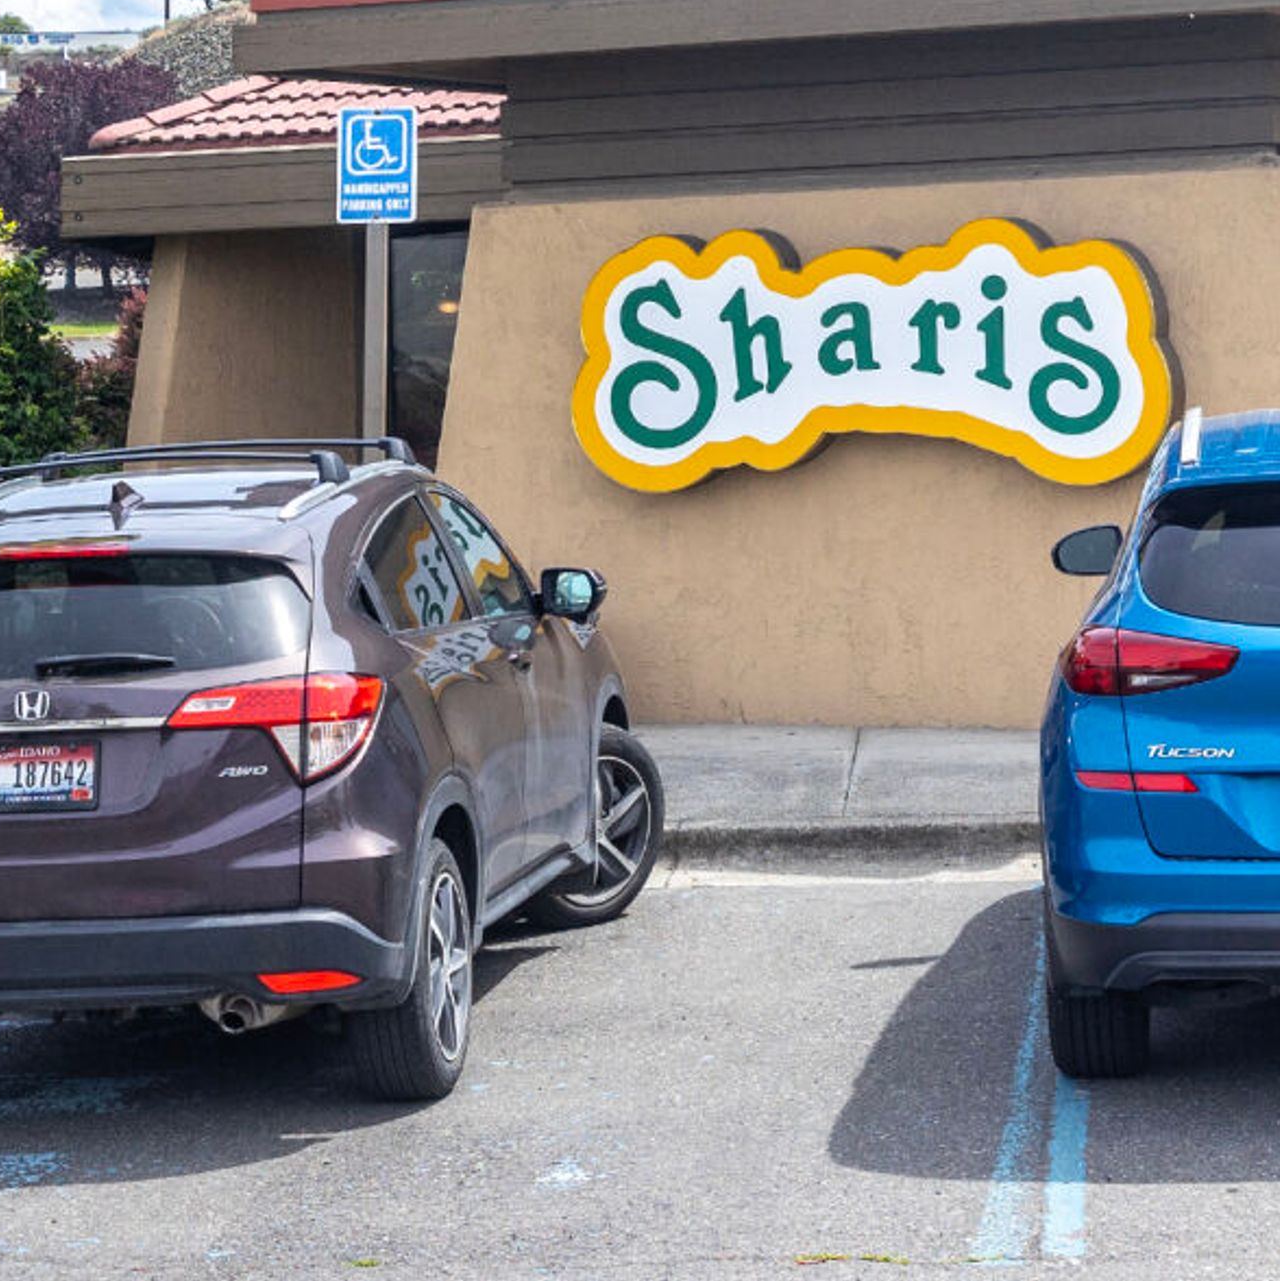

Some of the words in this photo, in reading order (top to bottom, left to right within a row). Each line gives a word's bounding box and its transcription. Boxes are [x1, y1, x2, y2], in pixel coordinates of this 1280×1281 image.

[343, 182, 410, 194] HANDICAPPED
[343, 199, 382, 211] PARKING
[385, 198, 410, 211] ONLY
[609, 274, 1121, 449] Sharis
[19, 746, 62, 759] IDAHO
[13, 759, 88, 788] 187642
